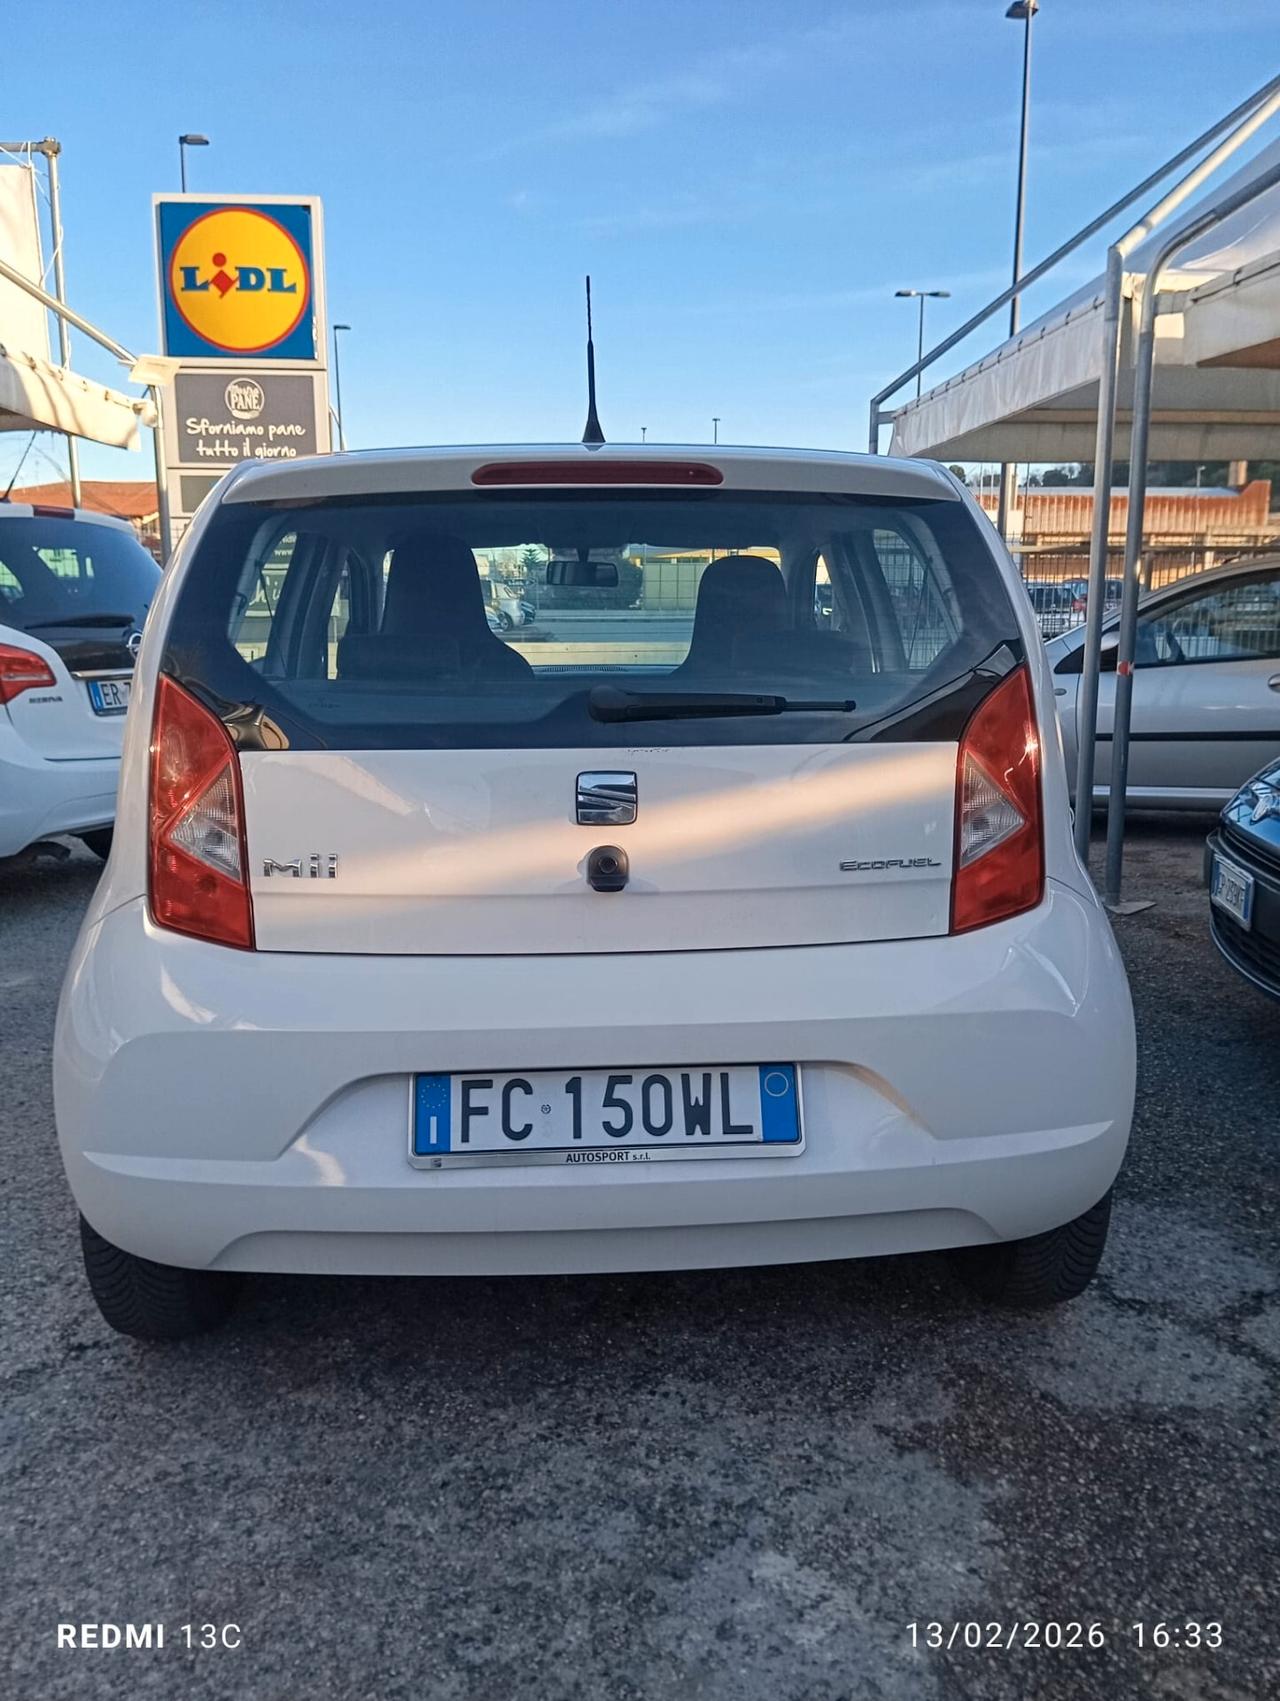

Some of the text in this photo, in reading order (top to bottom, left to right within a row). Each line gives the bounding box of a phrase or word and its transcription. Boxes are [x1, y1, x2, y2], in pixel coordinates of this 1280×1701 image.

[230, 393, 260, 410] PANE
[185, 417, 306, 441] Sforniamo pane
[196, 437, 297, 459] tutto il giorno
[100, 683, 122, 706] ER
[461, 1078, 533, 1144] FC
[565, 1072, 754, 1140] 150WL
[566, 1151, 630, 1163] AUTOSPORT
